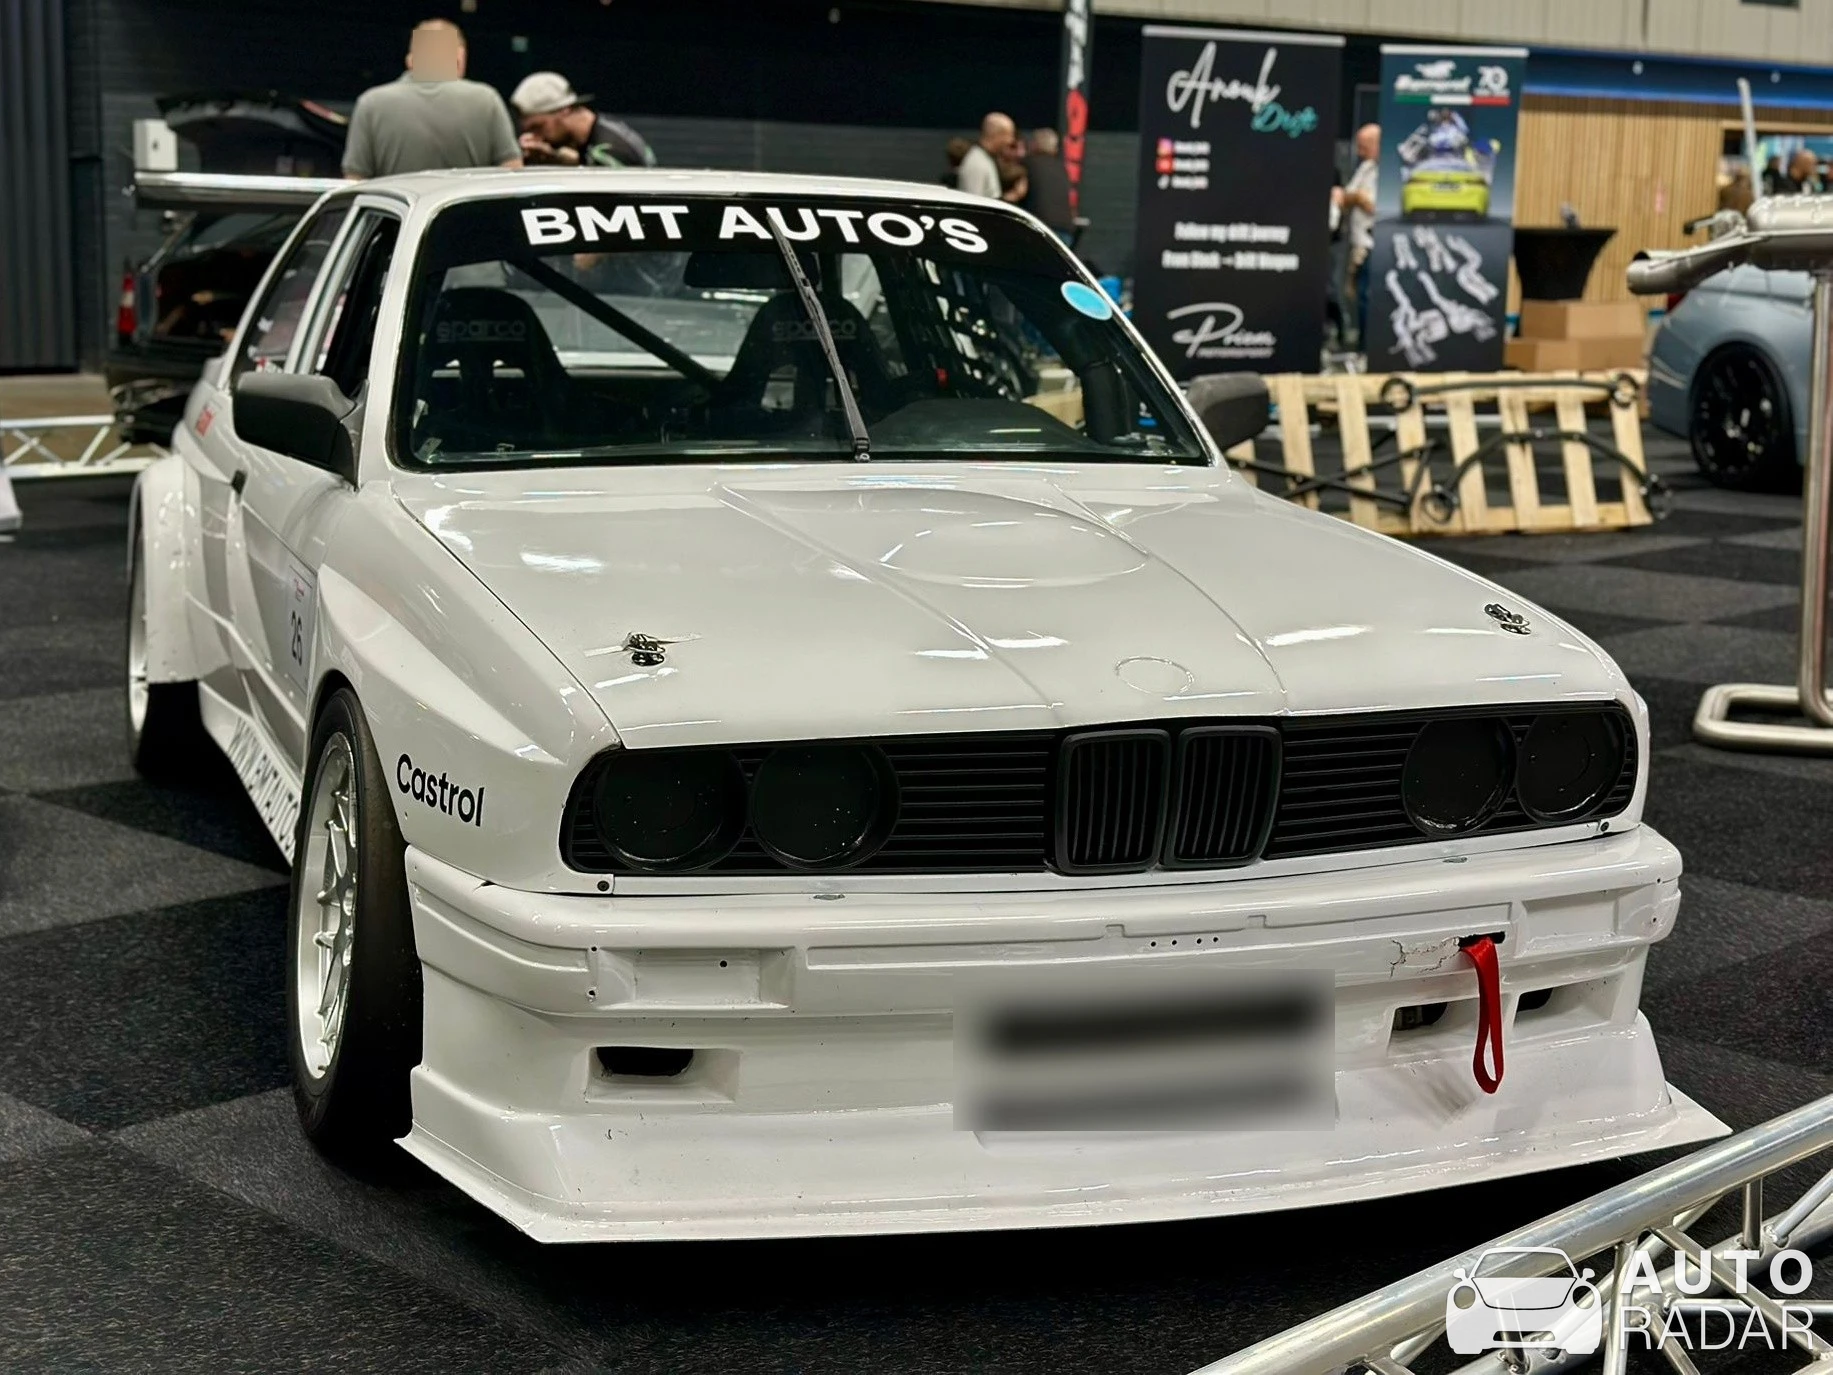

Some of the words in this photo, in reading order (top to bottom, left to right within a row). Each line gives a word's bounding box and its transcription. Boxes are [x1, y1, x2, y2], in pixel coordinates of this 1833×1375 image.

[520, 205, 689, 245] BMT
[719, 206, 988, 253] AUTO'S
[397, 754, 485, 827] Castrol
